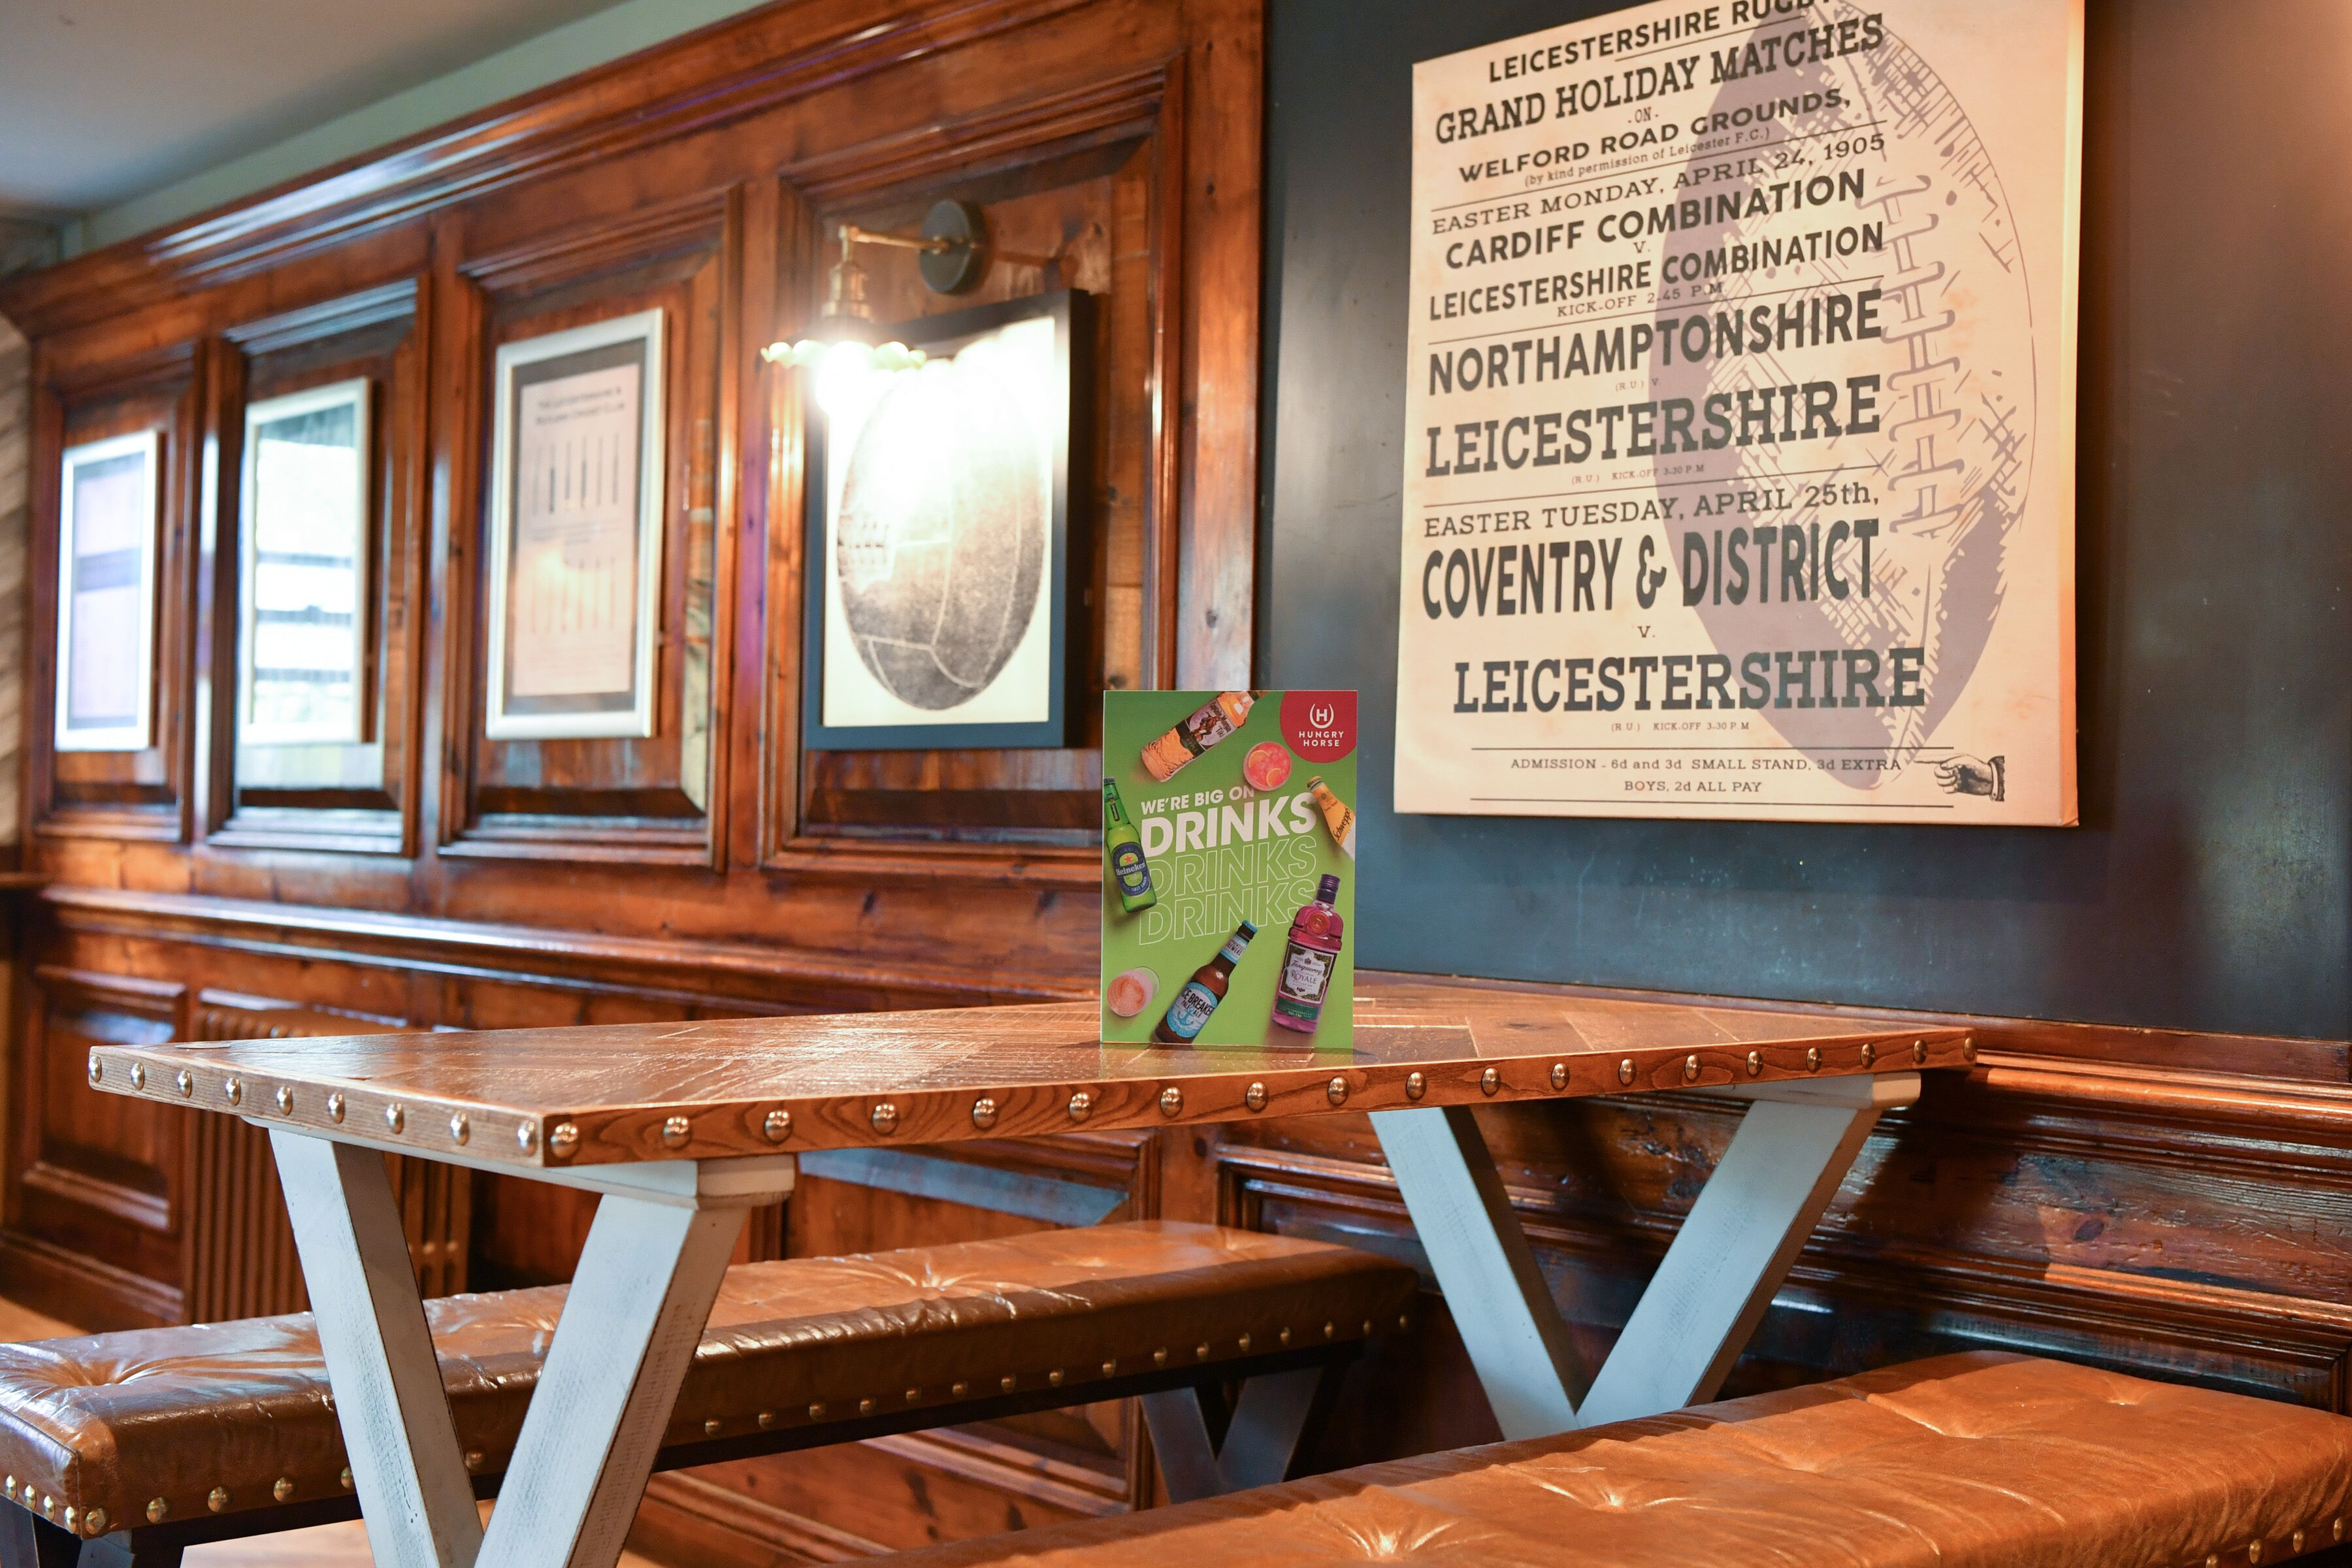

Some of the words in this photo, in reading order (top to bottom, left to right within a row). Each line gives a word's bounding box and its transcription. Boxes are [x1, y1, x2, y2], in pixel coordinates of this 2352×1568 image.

[1490, 7, 1720, 83] LEICESTERSHIRE
[1732, 0, 1829, 25] RUG
[1436, 93, 1545, 144] GRAND
[1556, 56, 1700, 118] HOLIDAY
[1710, 13, 1883, 84] MATCHES
[1459, 142, 1589, 182] WELFORD
[1601, 123, 1678, 155] ROAD
[1691, 88, 1850, 135] GROUNDS,
[1525, 173, 1544, 188] (by
[1548, 169, 1573, 182] kind
[1578, 153, 1648, 177] permission
[1653, 148, 1665, 161] of
[1669, 131, 1730, 157] Leicester
[1735, 127, 1770, 143] F.C.)
[1432, 203, 1531, 235] EASTER
[1541, 177, 1664, 214] MONDAY,
[1673, 158, 1763, 189] APRIL
[1774, 149, 1814, 171] 24,
[1823, 133, 1885, 160] 1905
[1446, 220, 1584, 269] CARDIFF
[1597, 168, 1864, 242] COMBINATION
[1429, 261, 1651, 321] LEICESTERSHIRE
[1662, 221, 1883, 284] COMBINATION
[1429, 289, 1882, 395] NORTHAMPTONSHIRE
[1426, 374, 1881, 478] LEICESTERSHIRE
[1424, 510, 1531, 537] EASTER
[1542, 497, 1684, 529] TUESDAY,
[1693, 489, 1792, 516] APRIL
[1805, 482, 1878, 508] 25th,
[1423, 538, 1623, 620] COVENTRY
[1636, 534, 1667, 610] &
[1682, 518, 1879, 607] DISTRICT
[1454, 647, 1925, 713] LEICESTERSHIRE
[1194, 789, 1224, 806] BIG
[1229, 785, 1254, 801] ON
[1511, 759, 1596, 769] ADMISSION
[1611, 759, 1628, 769] 6d
[1633, 759, 1659, 770] and
[1665, 759, 1682, 770] 3d
[1691, 759, 1746, 770] SMALL
[1752, 759, 1811, 771] STAND,
[1817, 759, 1835, 770] 3d
[1841, 759, 1902, 771] EXTRA
[1624, 781, 1670, 792] BOYS,
[1674, 781, 1691, 792] 2d
[1696, 782, 1727, 792] ALL
[1732, 782, 1762, 792] PAY
[1141, 792, 1316, 858] DRINKS
[1145, 835, 1316, 899] DRINKS
[1139, 879, 1316, 945] DRINKS
[1291, 970, 1318, 985] ROYALE
